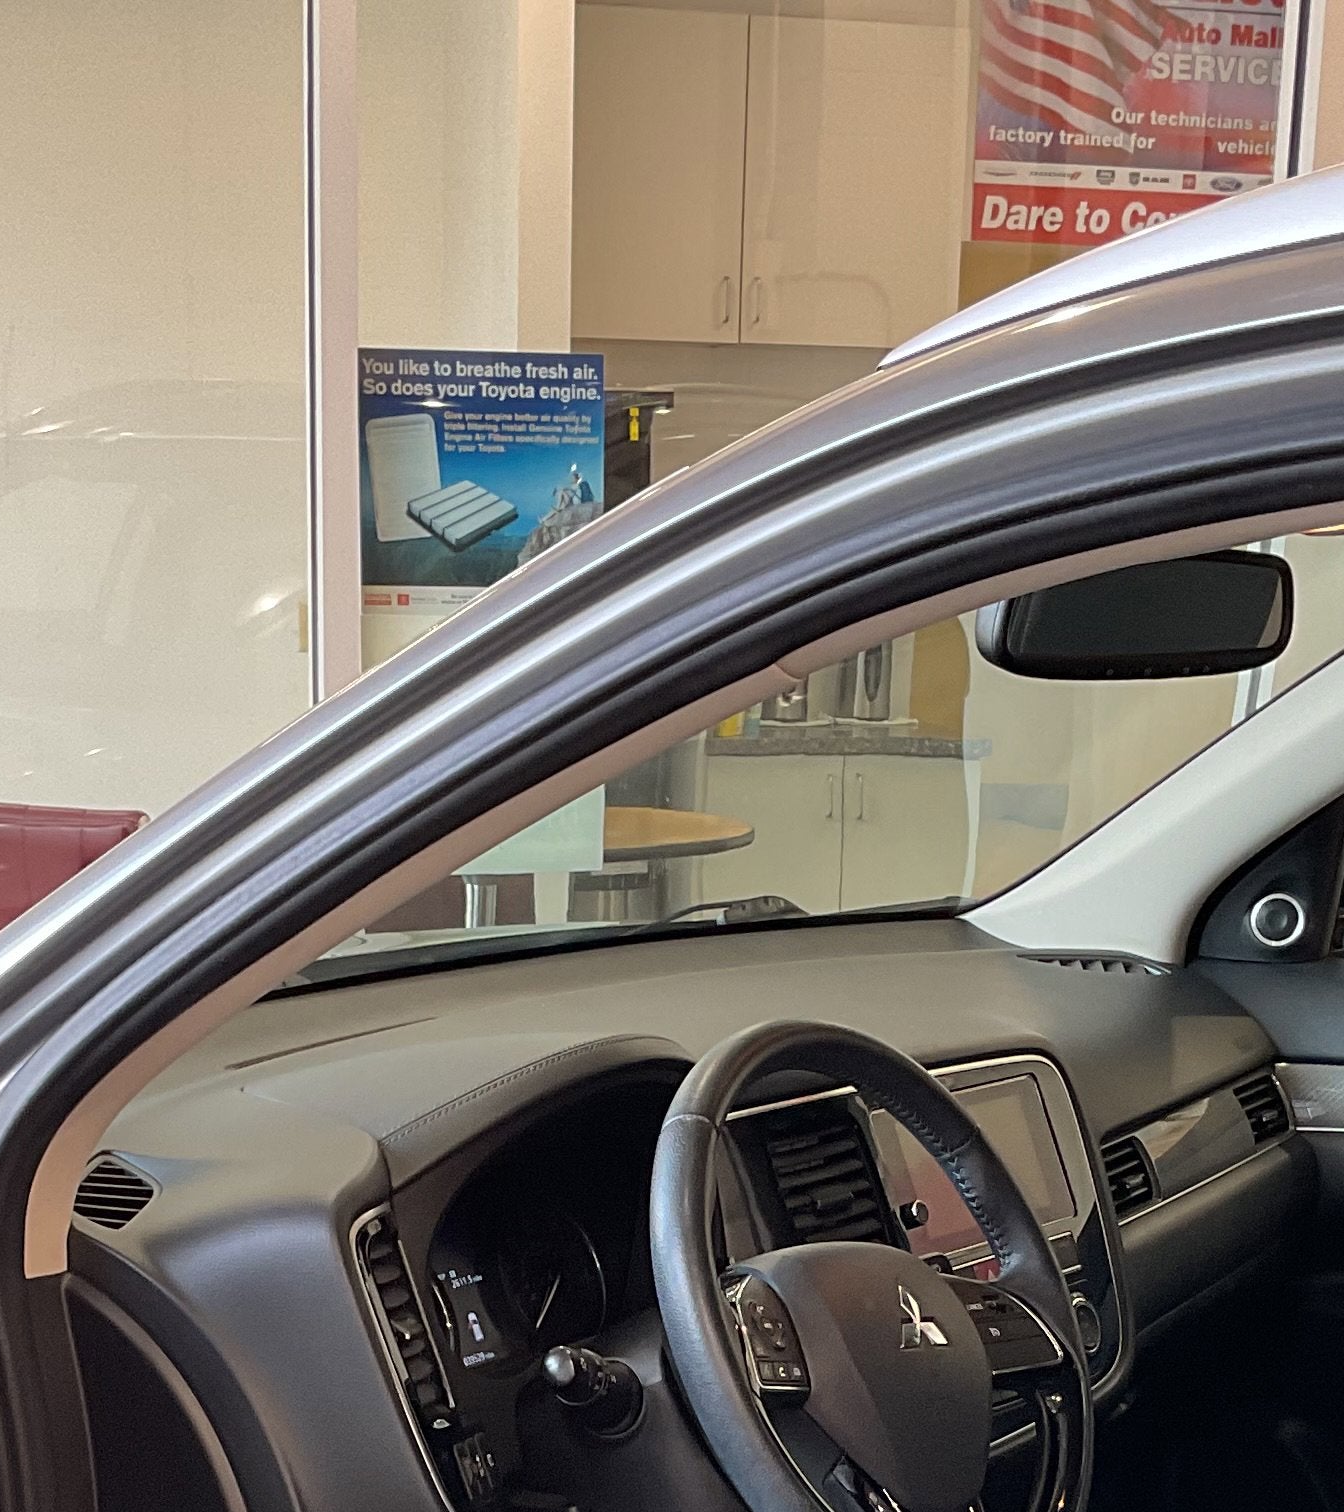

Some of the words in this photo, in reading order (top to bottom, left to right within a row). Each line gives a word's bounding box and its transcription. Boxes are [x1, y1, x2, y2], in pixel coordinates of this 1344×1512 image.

[1111, 107, 1144, 125] Our
[1151, 110, 1253, 130] technicians
[989, 125, 1053, 147] factory
[1059, 130, 1124, 148] trained
[1130, 133, 1155, 149] for
[981, 195, 1063, 232] Dare
[1075, 201, 1110, 234] to
[362, 358, 394, 374] You
[399, 359, 429, 375] like
[433, 360, 451, 376] to
[456, 360, 521, 378] breathe
[525, 362, 568, 379] fresh
[573, 363, 598, 380] air.
[363, 378, 386, 395] So
[391, 379, 433, 395] does
[437, 383, 475, 399] your
[479, 382, 535, 401] Toyota
[539, 384, 600, 403] engine.
